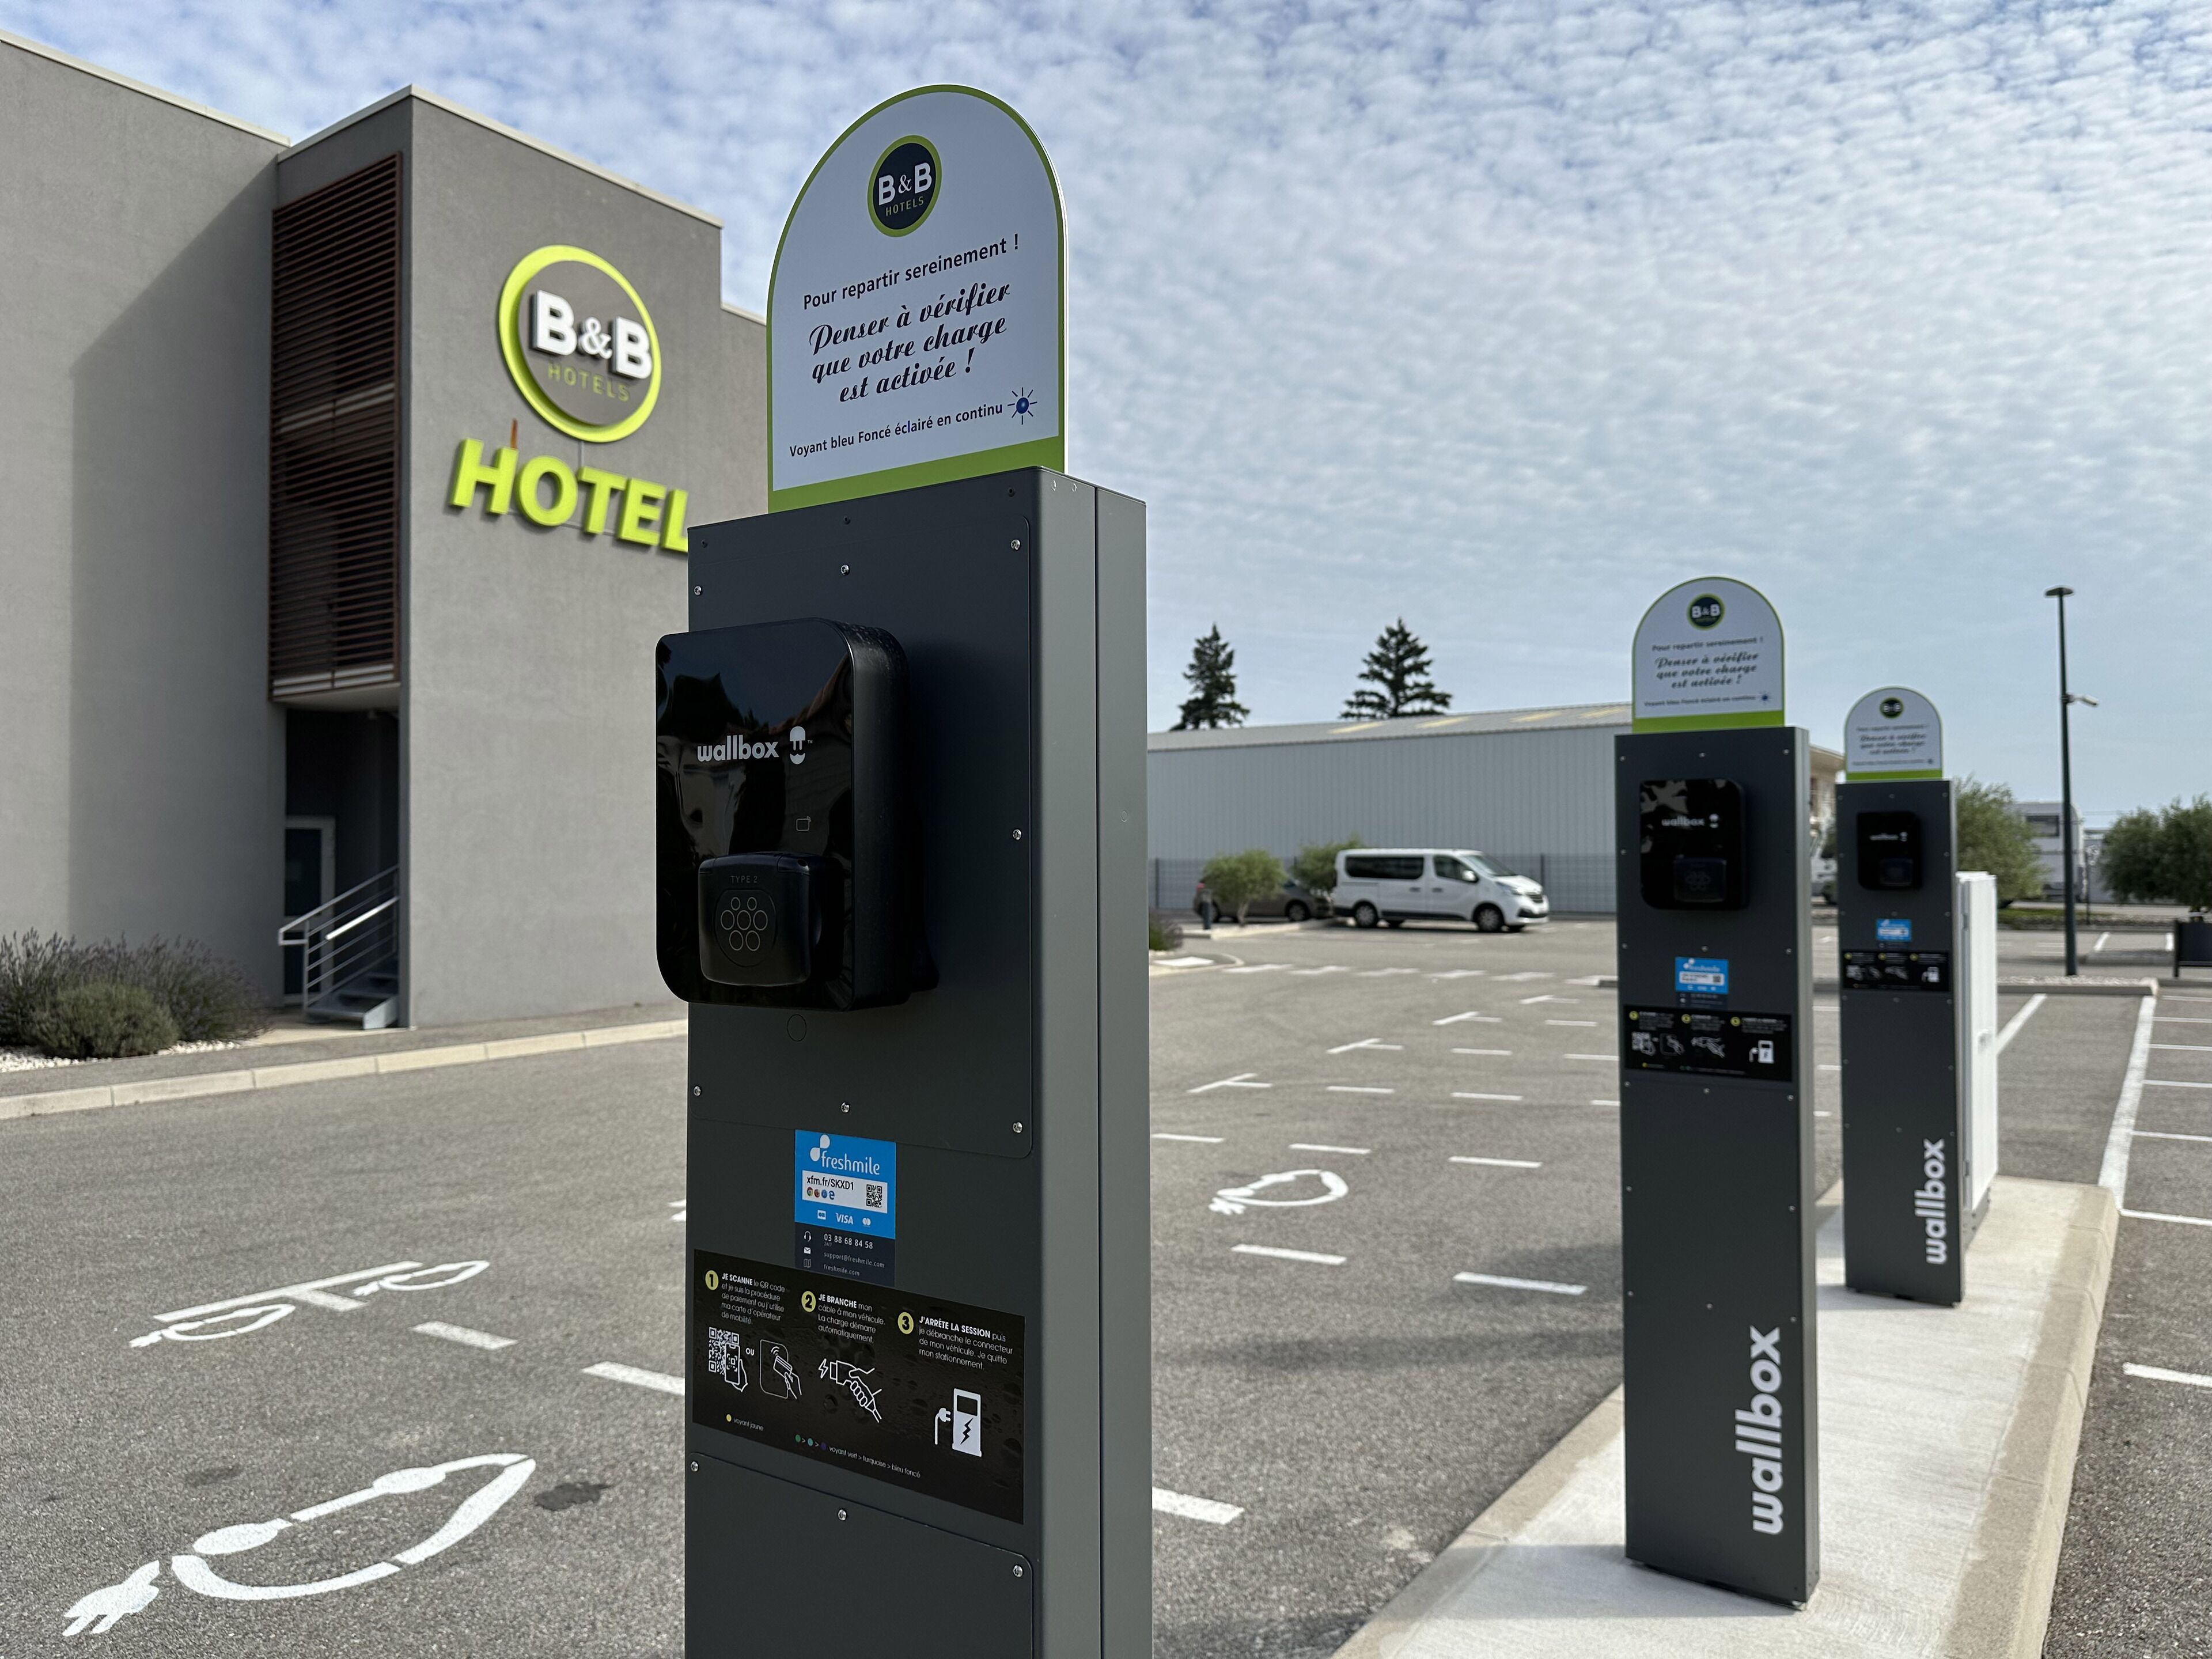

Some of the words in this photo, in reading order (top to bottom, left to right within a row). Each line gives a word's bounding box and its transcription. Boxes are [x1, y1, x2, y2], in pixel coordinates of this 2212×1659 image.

[878, 162, 932, 206] B&B
[885, 196, 924, 217] HOTELS
[804, 289, 836, 310] Pour
[842, 270, 900, 299] repartir
[905, 238, 1007, 281] sereinement
[1014, 233, 1019, 250] !
[809, 316, 889, 355] Penser
[896, 305, 911, 328] à
[919, 282, 1010, 322] vérifier
[532, 289, 652, 380] B&B
[812, 357, 851, 384] que
[858, 340, 915, 368] votre
[923, 317, 1006, 352] charge
[547, 363, 630, 402] HOTELS
[839, 376, 869, 402] est
[876, 356, 956, 394] activée
[965, 347, 975, 373] !
[789, 440, 827, 457] Voyant
[831, 435, 854, 449] bleu
[858, 425, 891, 443] Foncé
[894, 416, 933, 435] éclairé
[937, 413, 951, 426] en
[956, 402, 1003, 423] continu
[450, 438, 688, 553] HOTEL
[1692, 604, 1720, 618] B&B
[1652, 644, 1670, 652] Pour
[1673, 642, 1703, 651] repartir
[1706, 637, 1757, 648] sereinement
[1655, 657, 1698, 669] Penser
[1713, 652, 1759, 663] vérifier
[1656, 671, 1678, 680] que
[1681, 667, 1711, 677] votre
[1715, 664, 1757, 674] charge
[1671, 679, 1687, 689] est
[1691, 676, 1733, 687] activée
[698, 734, 779, 762] wallbox
[821, 1150, 880, 1175] freshmile
[806, 1175, 854, 1190] xfm.fr/SKXD1
[1914, 1138, 1947, 1264] wallbox
[835, 1213, 853, 1225] VISA
[824, 1233, 832, 1241] 03
[834, 1236, 842, 1244] 88
[844, 1237, 852, 1245] 68
[855, 1239, 862, 1247] 84
[865, 1241, 873, 1249] 58
[824, 1252, 885, 1268] support@freshmile.com
[824, 1264, 859, 1276] freshmile.com
[729, 1274, 752, 1286] SCANNE
[770, 1283, 785, 1293] code
[730, 1294, 756, 1306] paiement
[751, 1290, 780, 1301] procédure
[827, 1295, 857, 1308] BRANCHE
[858, 1303, 872, 1312] mon
[732, 1305, 746, 1313] carte
[819, 1304, 836, 1313] câble
[843, 1310, 857, 1319] mon
[827, 1317, 849, 1328] charge
[850, 1321, 876, 1334] démarre
[951, 1323, 959, 1331] LA
[961, 1325, 990, 1338] SESSION
[992, 1333, 1006, 1342] puis
[926, 1329, 964, 1343] débranche
[965, 1336, 971, 1344] le
[973, 1340, 1013, 1354] connecteur
[919, 1349, 934, 1358] mon
[930, 1340, 944, 1350] mon
[978, 1350, 986, 1359] Je
[987, 1353, 1007, 1365] quitte
[733, 1418, 749, 1427] voyant
[750, 1422, 764, 1431] jaune
[1734, 1325, 1783, 1535] wallbox
[829, 1446, 846, 1456] voyant
[863, 1455, 886, 1468] turquoise
[892, 1464, 904, 1474] bleu
[904, 1468, 921, 1478] foncé
